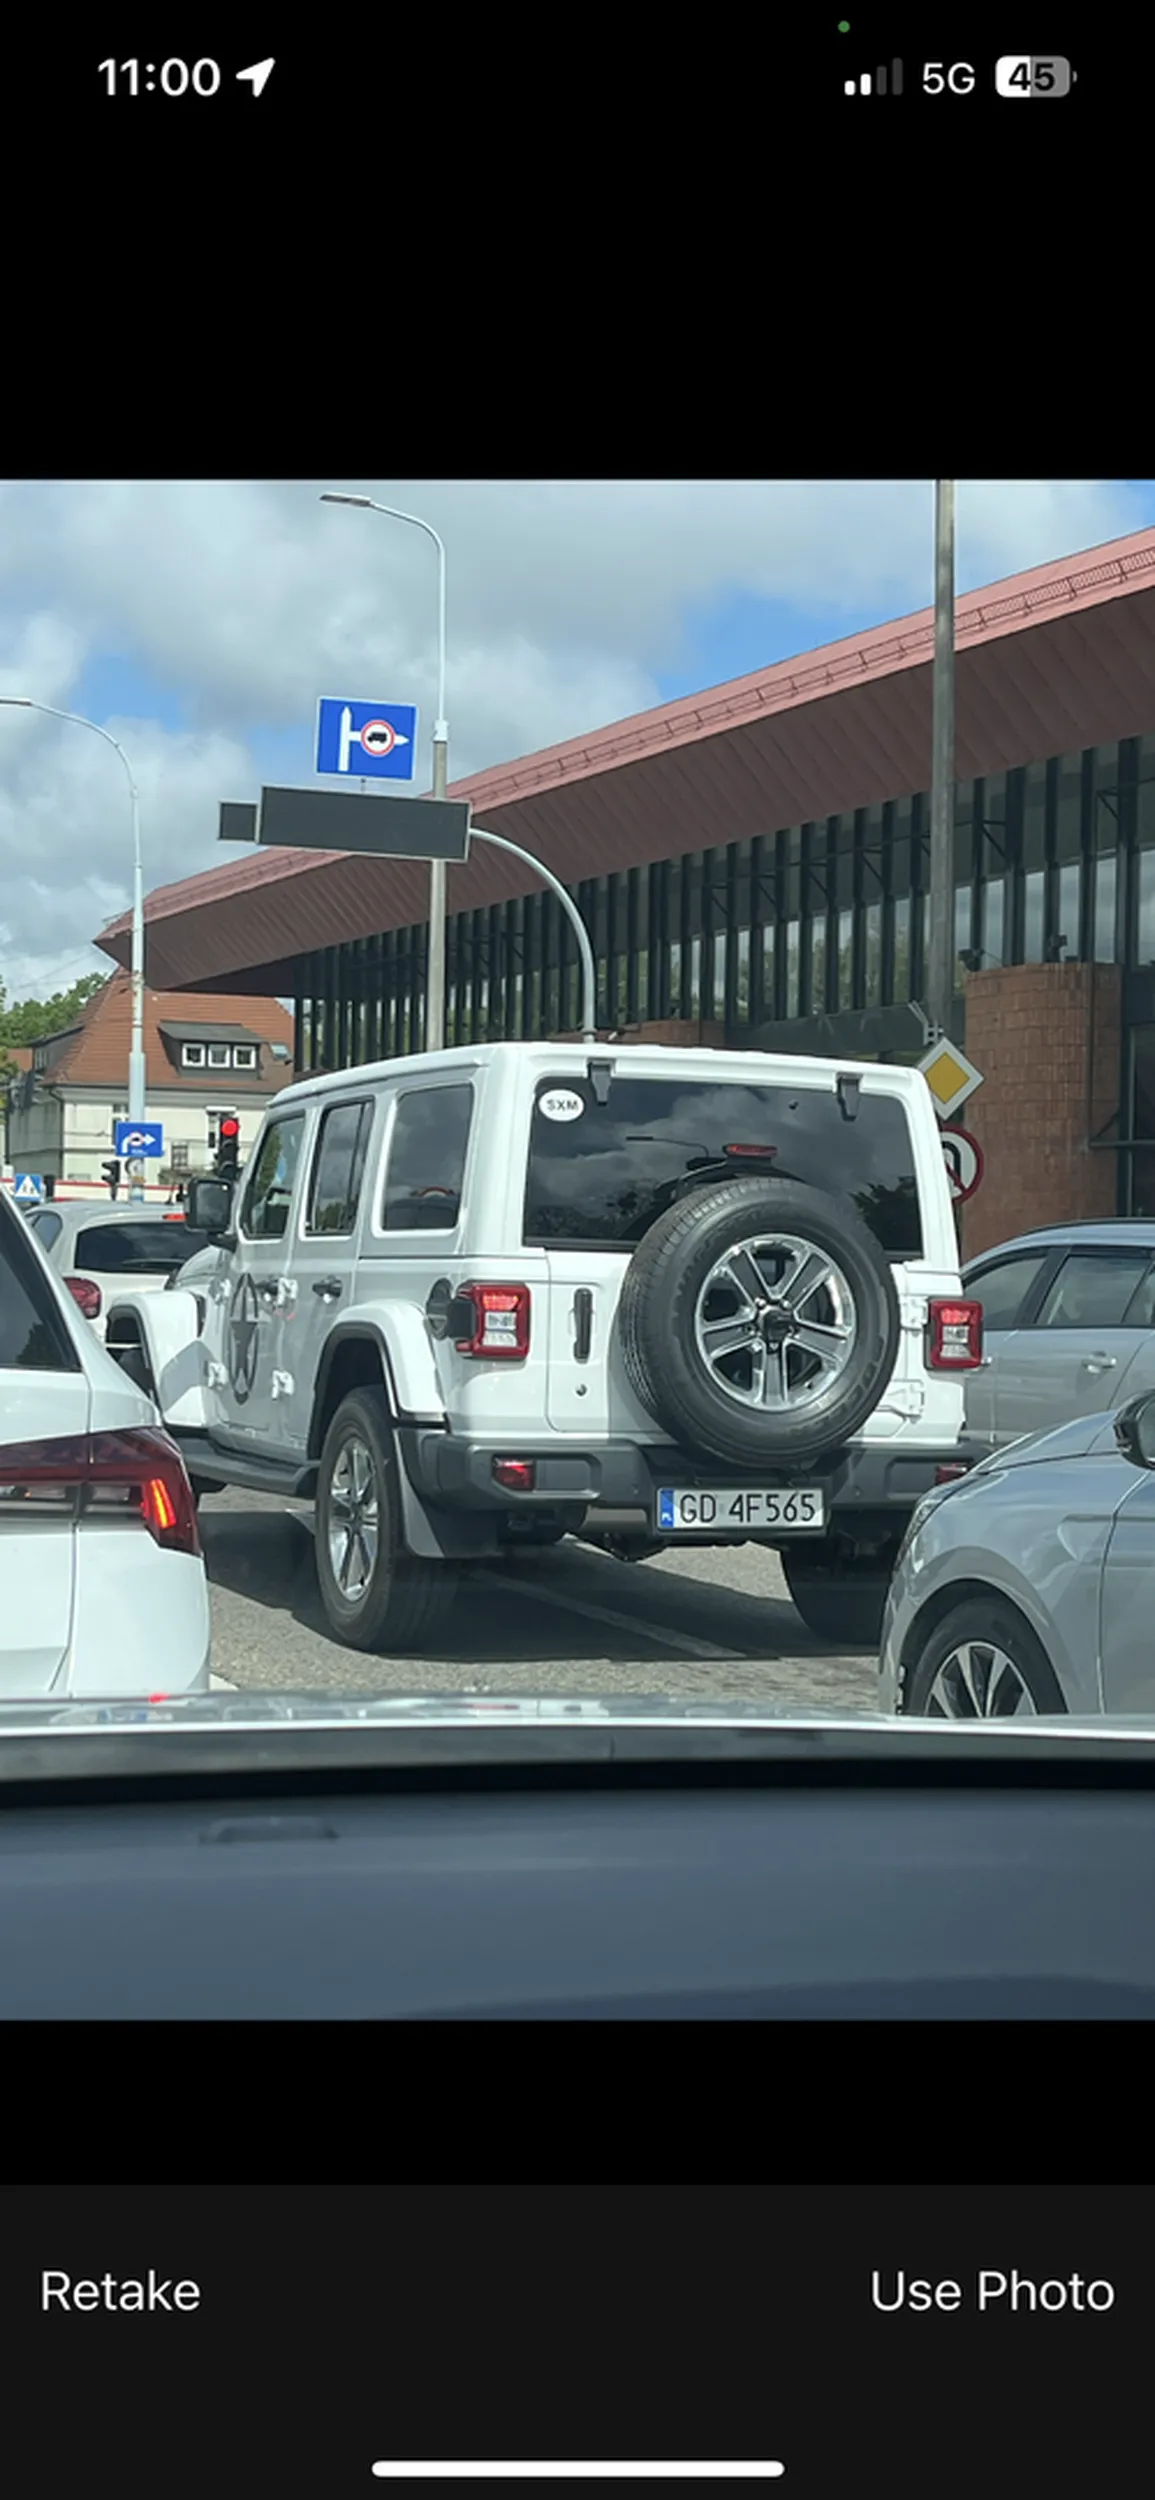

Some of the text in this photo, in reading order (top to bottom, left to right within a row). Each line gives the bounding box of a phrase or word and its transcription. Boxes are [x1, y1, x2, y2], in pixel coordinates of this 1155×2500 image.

[546, 1099, 579, 1111] SXM
[680, 1493, 816, 1523] GD 4F565
